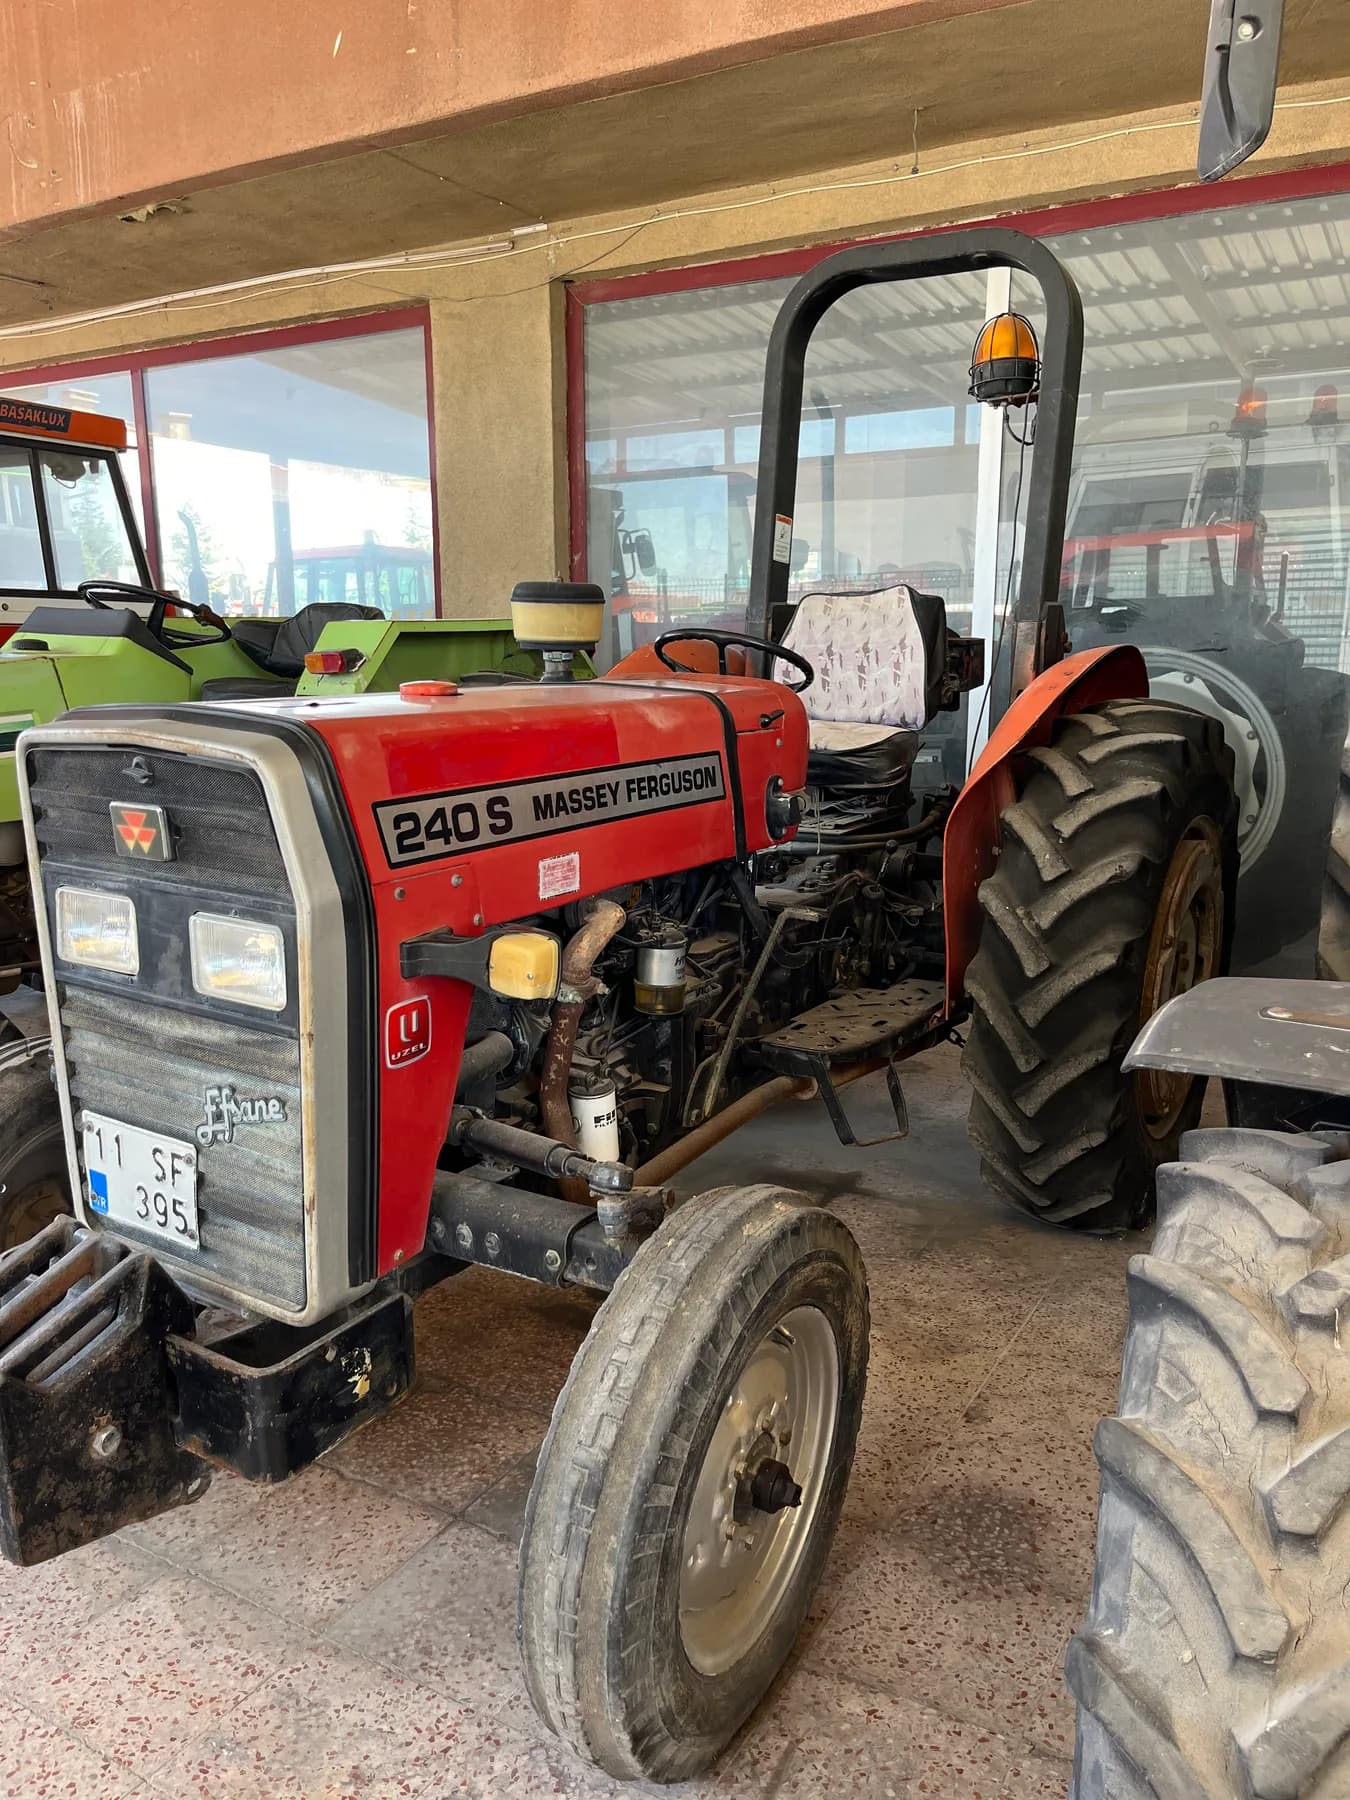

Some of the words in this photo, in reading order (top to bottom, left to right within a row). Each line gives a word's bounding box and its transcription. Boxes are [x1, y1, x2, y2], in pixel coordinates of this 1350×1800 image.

[532, 780, 621, 822] MASSEY
[625, 765, 717, 804] FERGUSON
[391, 1043, 427, 1061] UZEL
[95, 1127, 122, 1168] 11
[151, 1147, 183, 1188] SF
[136, 1185, 189, 1234] 395
